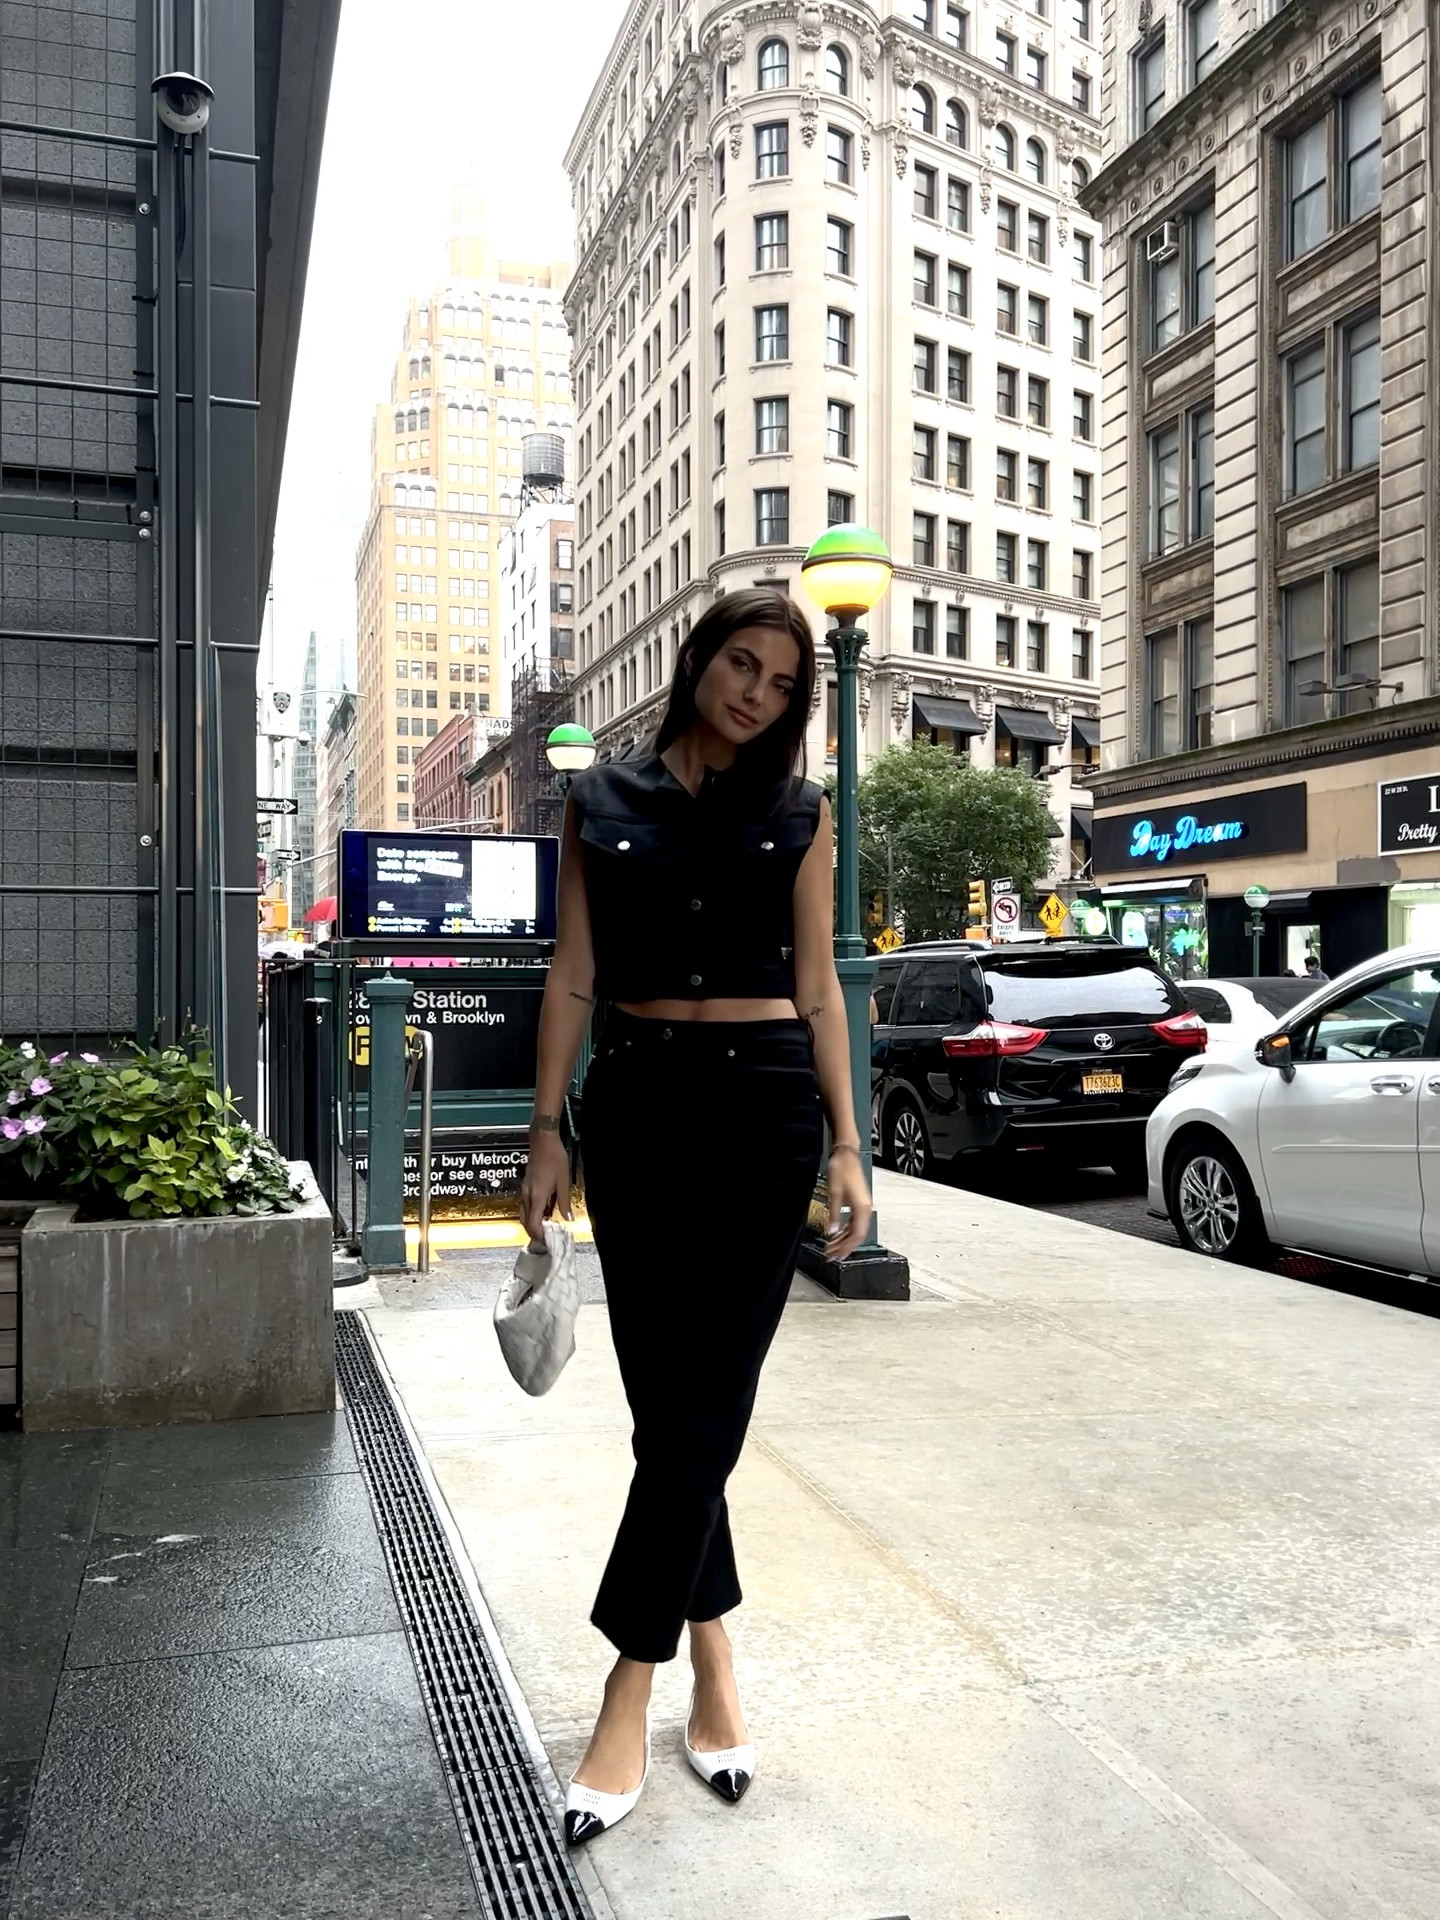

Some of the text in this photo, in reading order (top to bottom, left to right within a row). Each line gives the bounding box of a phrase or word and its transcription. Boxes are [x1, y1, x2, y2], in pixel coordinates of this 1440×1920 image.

[1130, 815, 1243, 861] Day Dream
[1397, 823, 1438, 843] Pretty
[413, 991, 487, 1009] Station
[426, 1012, 437, 1024] &
[442, 1011, 505, 1026] Brooklyn
[441, 1154, 466, 1168] buy
[471, 1152, 528, 1166] MetroCa
[430, 1171, 444, 1181] or
[449, 1170, 474, 1180] see
[479, 1167, 517, 1183] agent
